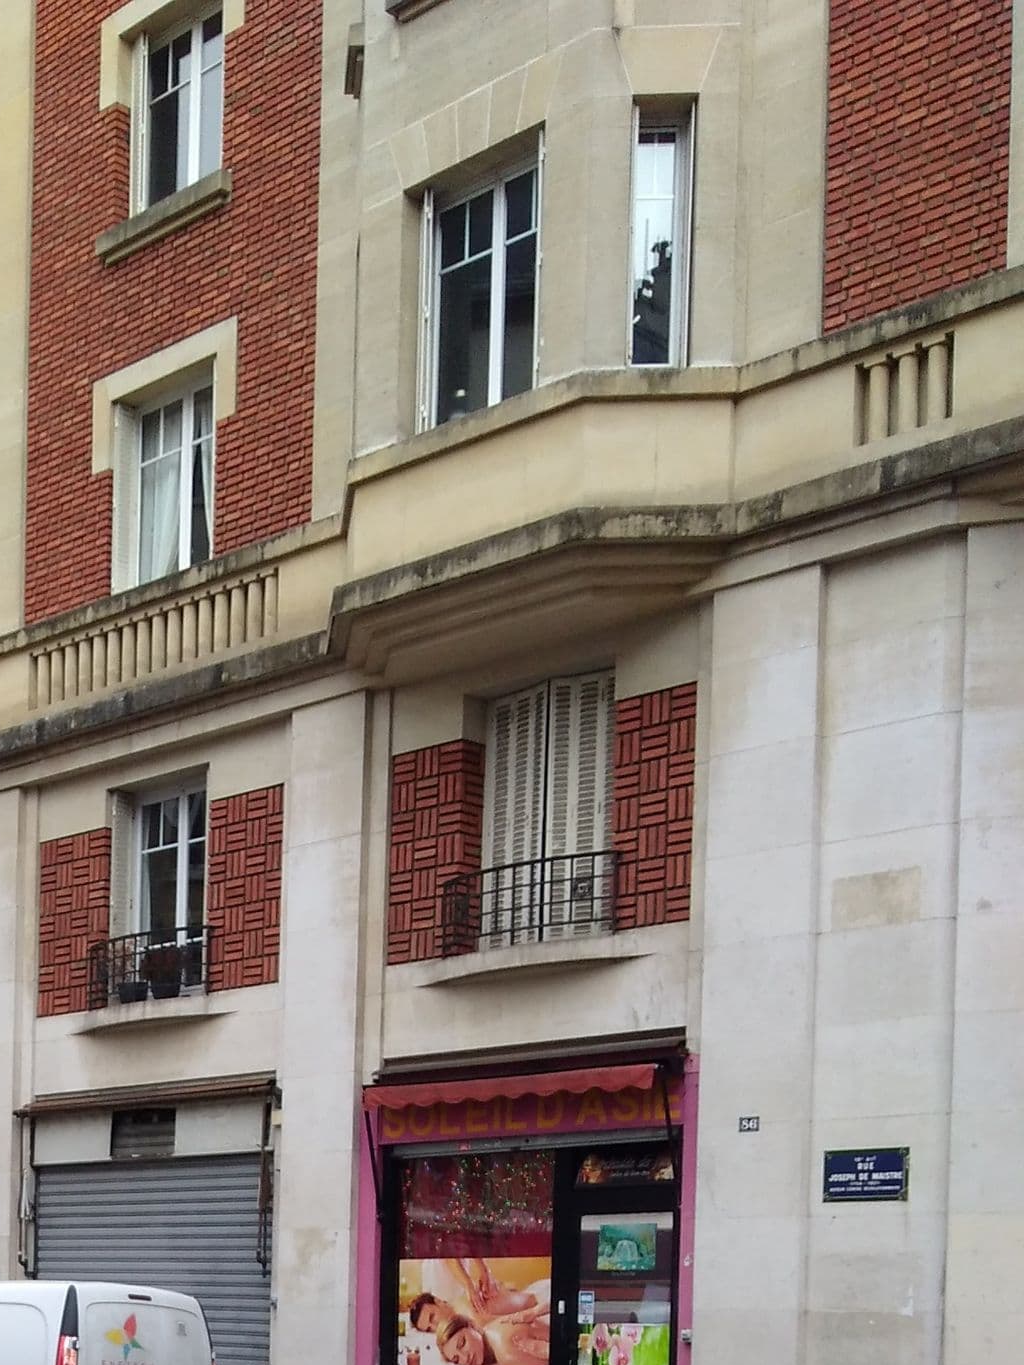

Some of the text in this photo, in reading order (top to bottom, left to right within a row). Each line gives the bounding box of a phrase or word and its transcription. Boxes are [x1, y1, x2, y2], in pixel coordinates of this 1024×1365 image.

[383, 1096, 528, 1138] SOLEIL
[857, 1162, 875, 1171] RUE
[828, 1171, 903, 1182] JOSEPH DE MAISTRE
